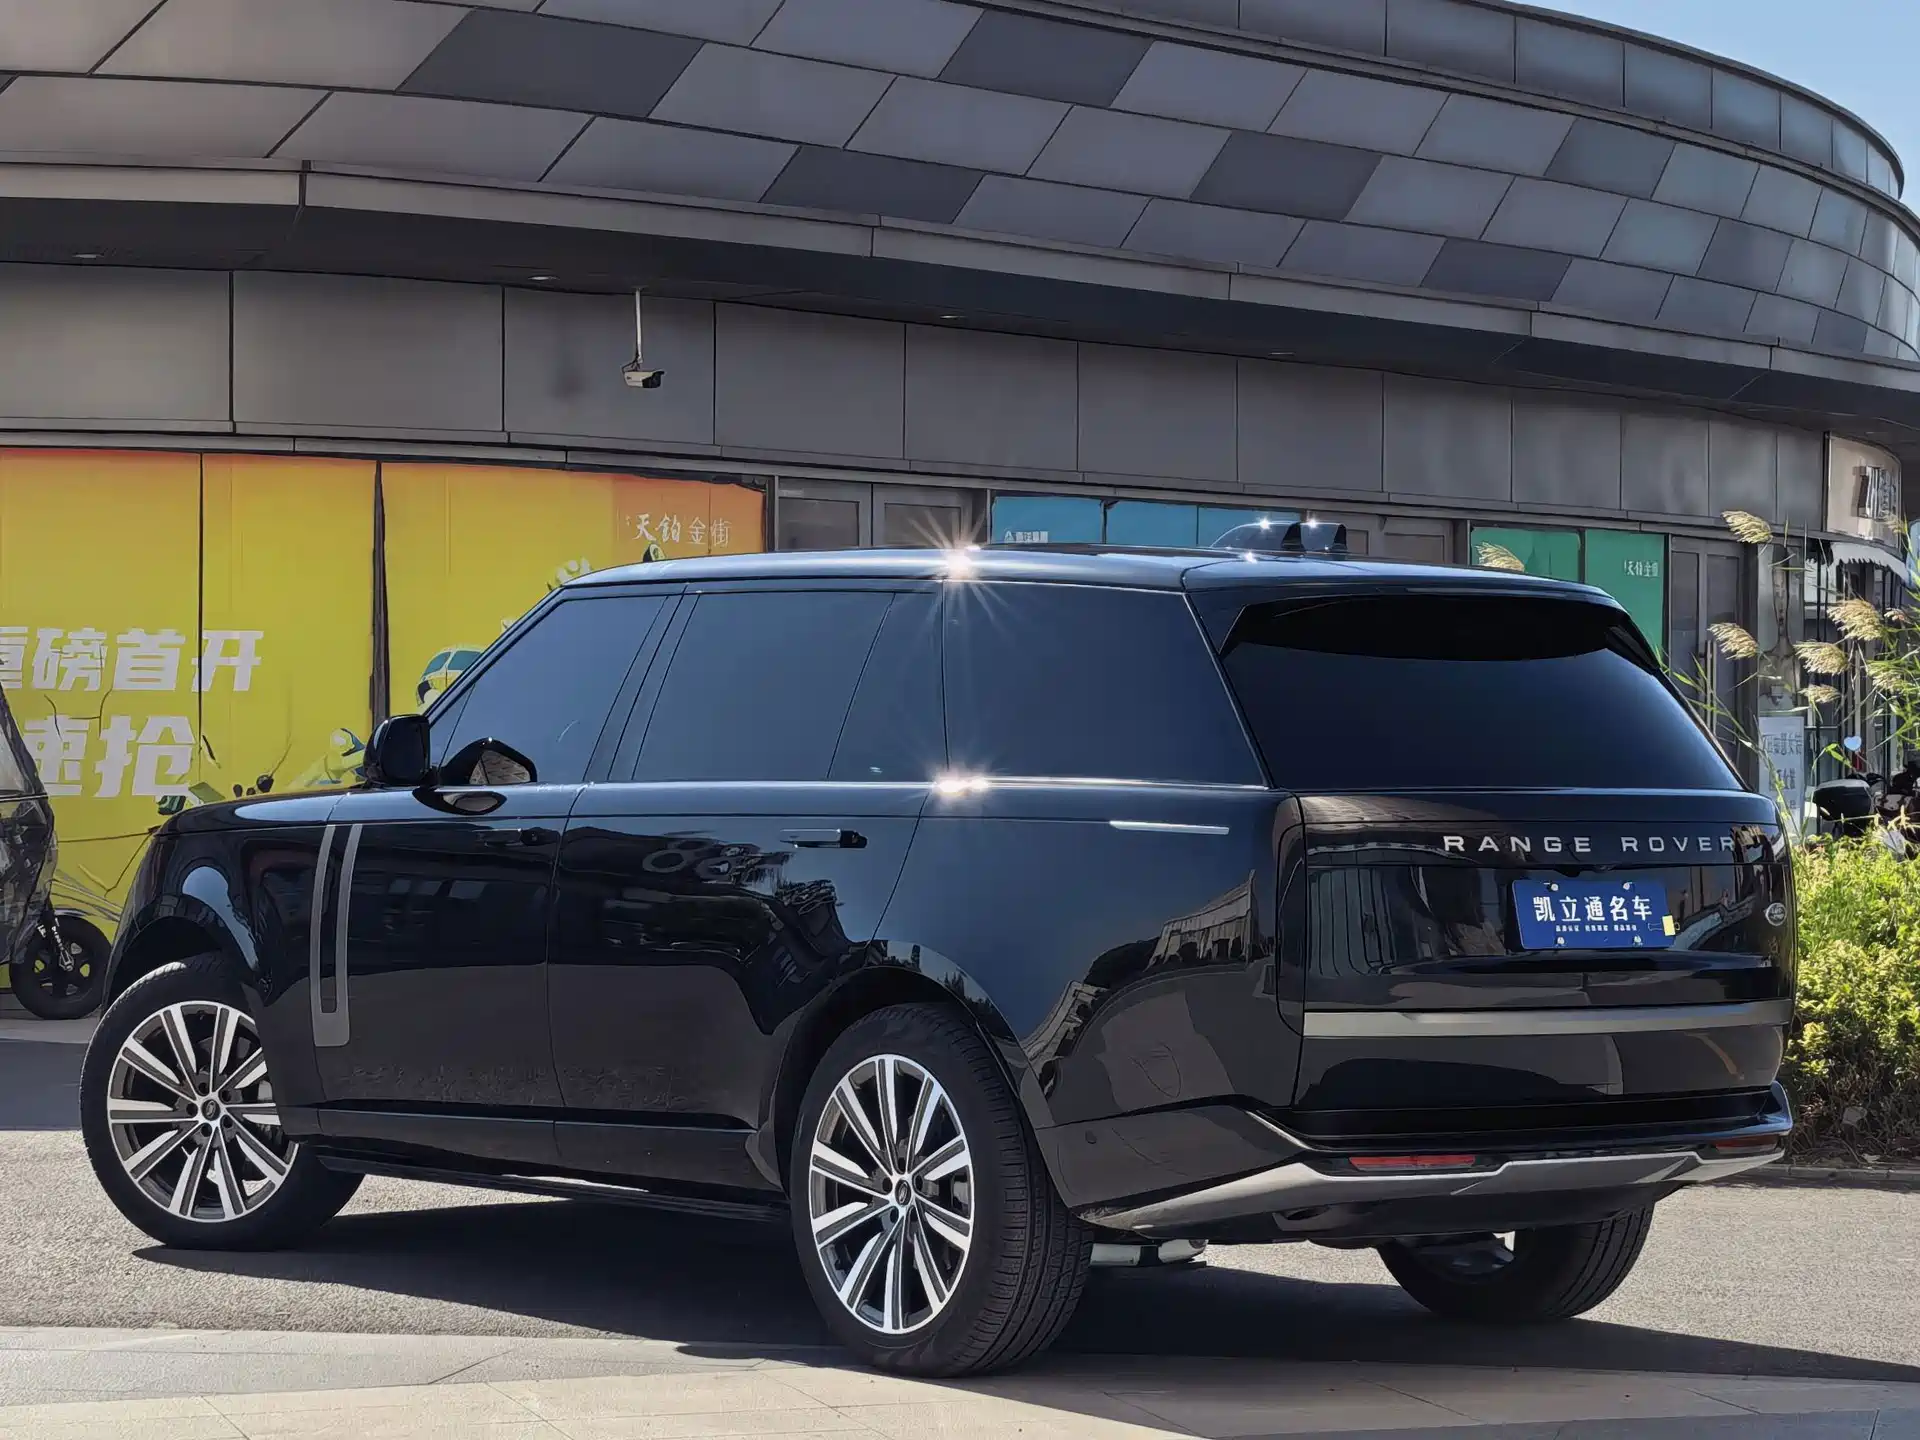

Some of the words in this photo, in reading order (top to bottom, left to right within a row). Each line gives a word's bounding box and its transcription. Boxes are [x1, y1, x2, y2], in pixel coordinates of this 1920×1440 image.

[1443, 835, 1591, 853] RANGE
[1621, 836, 1736, 852] ROVER
[1532, 895, 1653, 922] 凯立通名车
